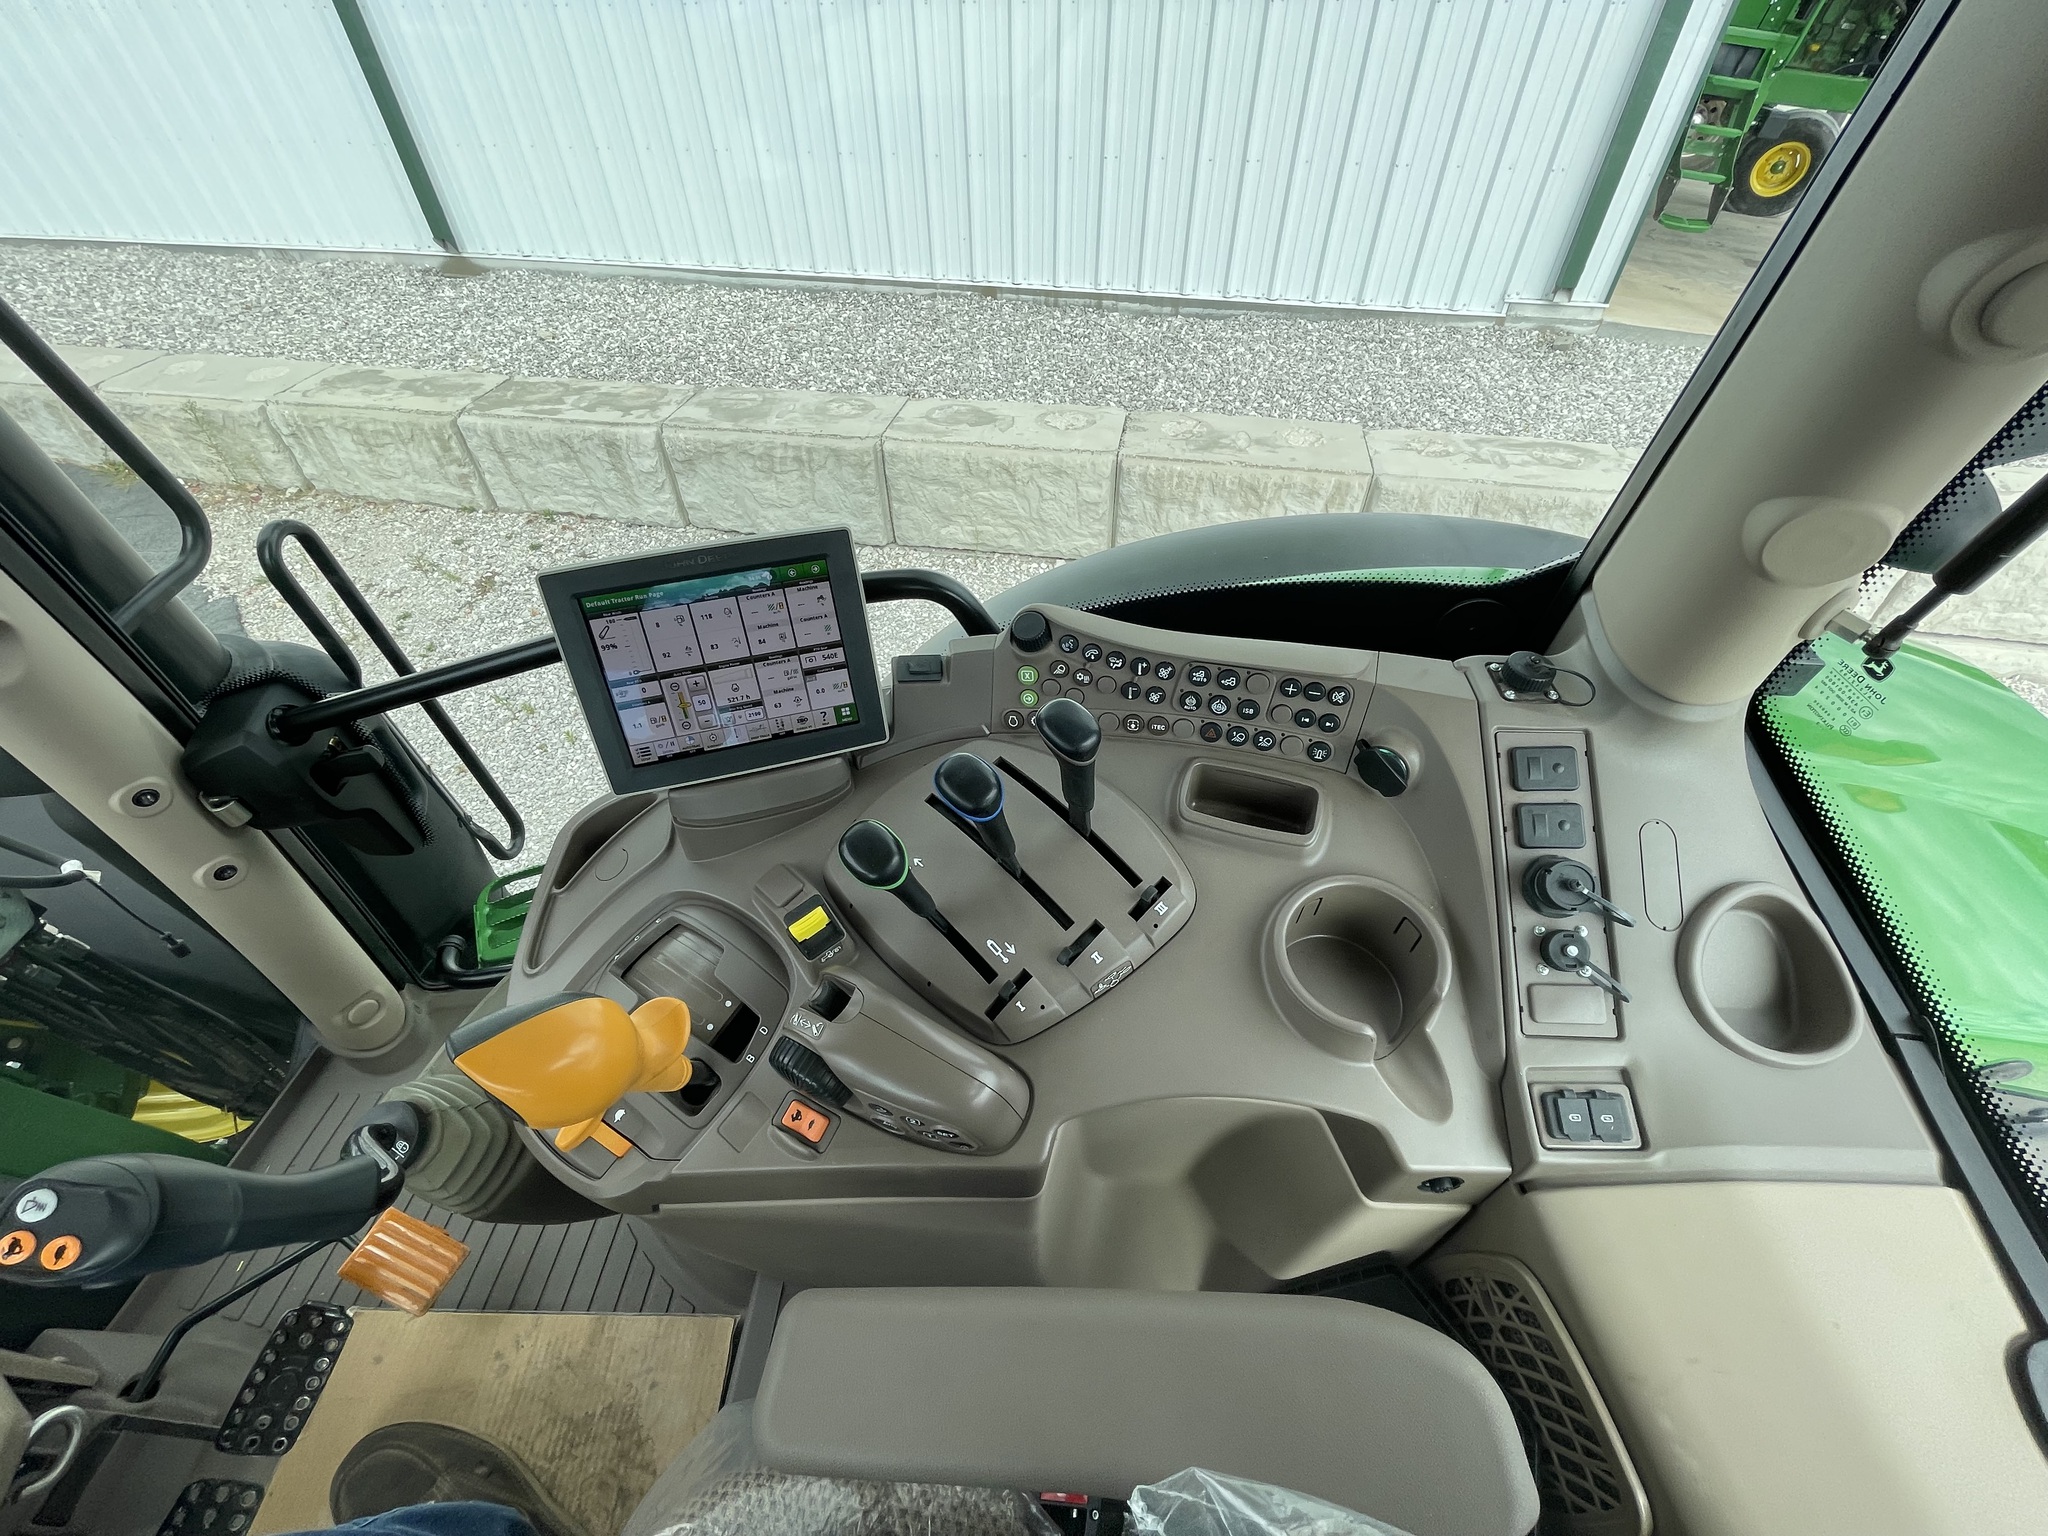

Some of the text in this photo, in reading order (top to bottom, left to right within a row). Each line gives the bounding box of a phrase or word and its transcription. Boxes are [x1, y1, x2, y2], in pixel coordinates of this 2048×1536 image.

[585, 599, 611, 608] Default
[610, 596, 634, 605] Tractor
[648, 591, 664, 599] Page
[746, 593, 770, 601] Counters
[800, 615, 823, 623] Counters
[757, 622, 779, 630] Machine
[600, 643, 618, 651] 99%
[821, 652, 839, 661] 540E
[773, 687, 794, 695] Machine
[727, 695, 744, 704] 521.7
[759, 1026, 768, 1035] D
[745, 1054, 755, 1063] B
